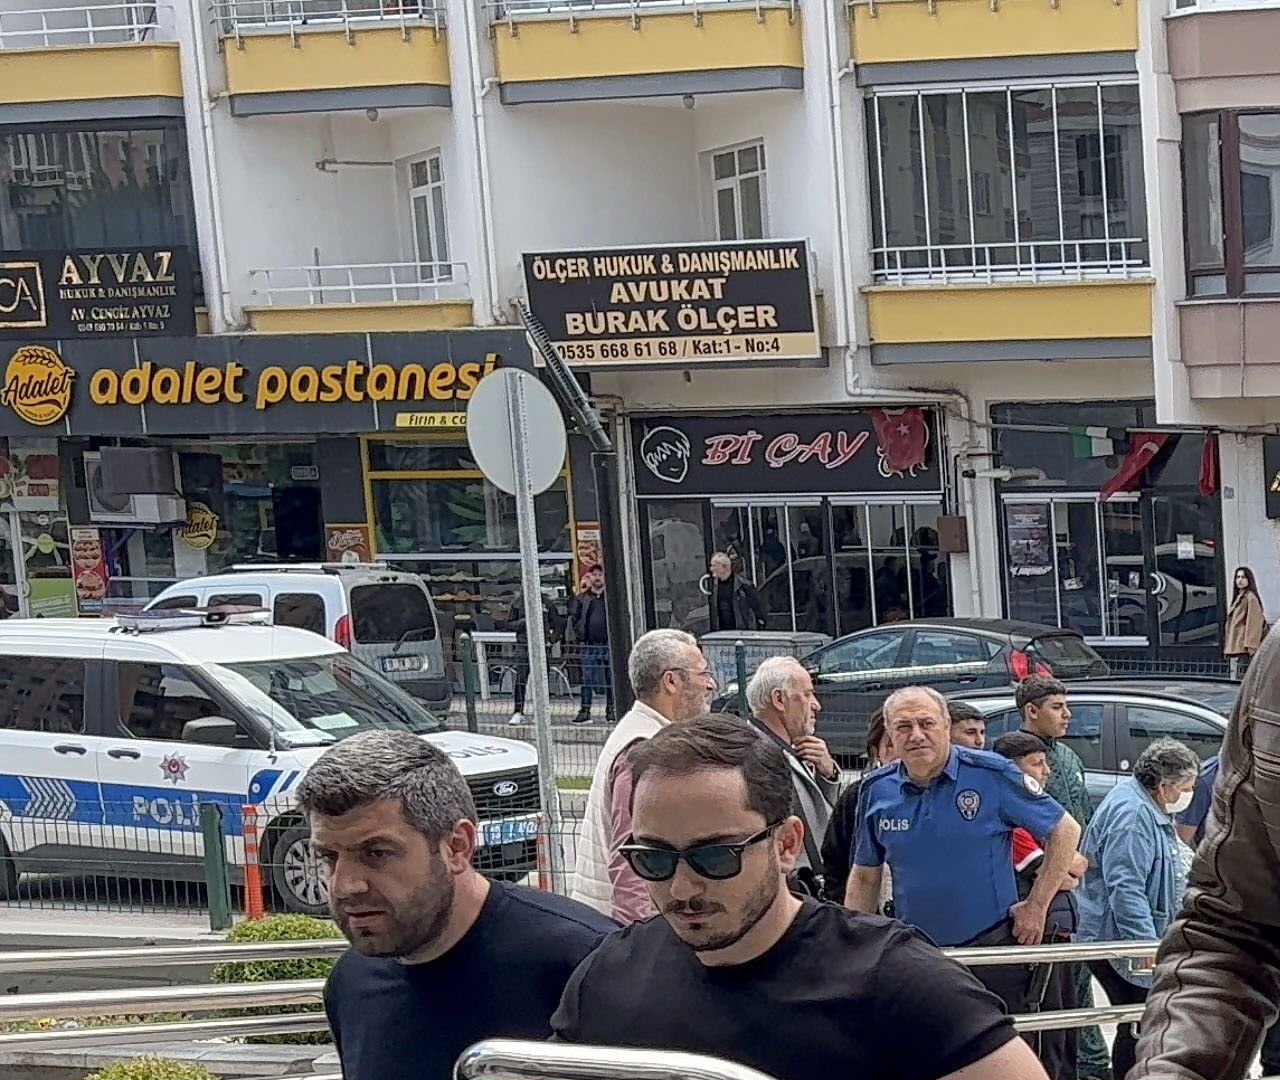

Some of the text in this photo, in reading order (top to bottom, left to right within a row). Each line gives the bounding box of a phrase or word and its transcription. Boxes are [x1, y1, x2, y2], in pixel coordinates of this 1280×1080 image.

[58, 251, 175, 285] AYVAZ
[532, 248, 800, 284] ÖLÇER HUKUK & DANIŞMANLIK
[59, 288, 96, 299] HUKUK
[610, 278, 727, 304] AVUKAT
[132, 305, 170, 318] AYVAZ
[565, 304, 778, 335] BURAK ÖLÇER
[600, 342, 629, 359] 668
[634, 342, 652, 357] 61
[658, 341, 678, 357] 68
[692, 339, 731, 355] Kat:1
[745, 337, 781, 354] No:4
[3, 367, 75, 405] Adalet
[89, 360, 244, 405] adalet
[133, 794, 199, 826] POLİ
